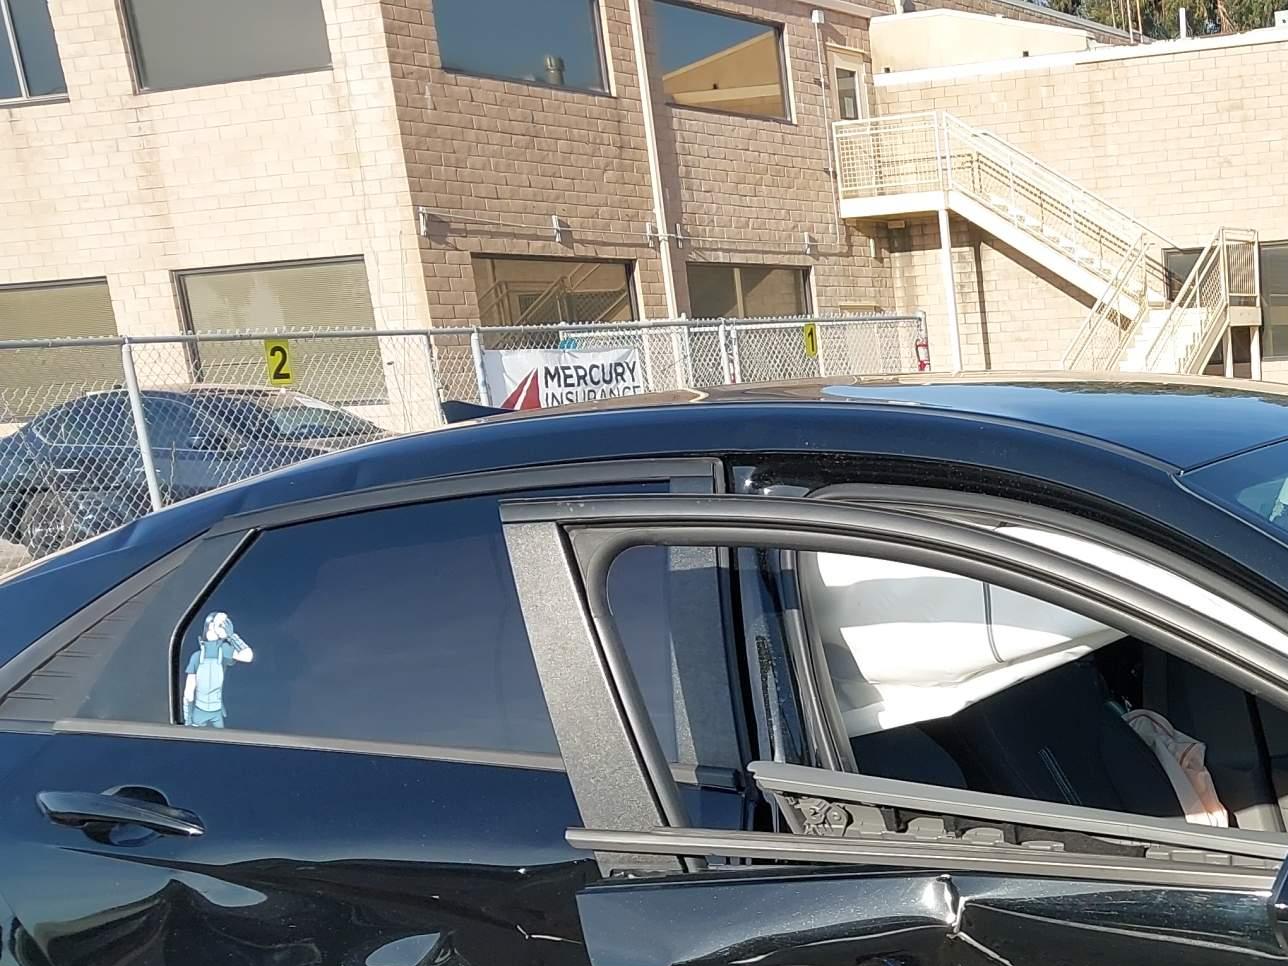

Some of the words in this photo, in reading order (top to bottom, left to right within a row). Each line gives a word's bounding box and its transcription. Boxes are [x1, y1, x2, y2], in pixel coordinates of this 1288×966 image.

[807, 327, 815, 352] 1
[270, 345, 290, 380] 2
[544, 361, 637, 388] MERCURY
